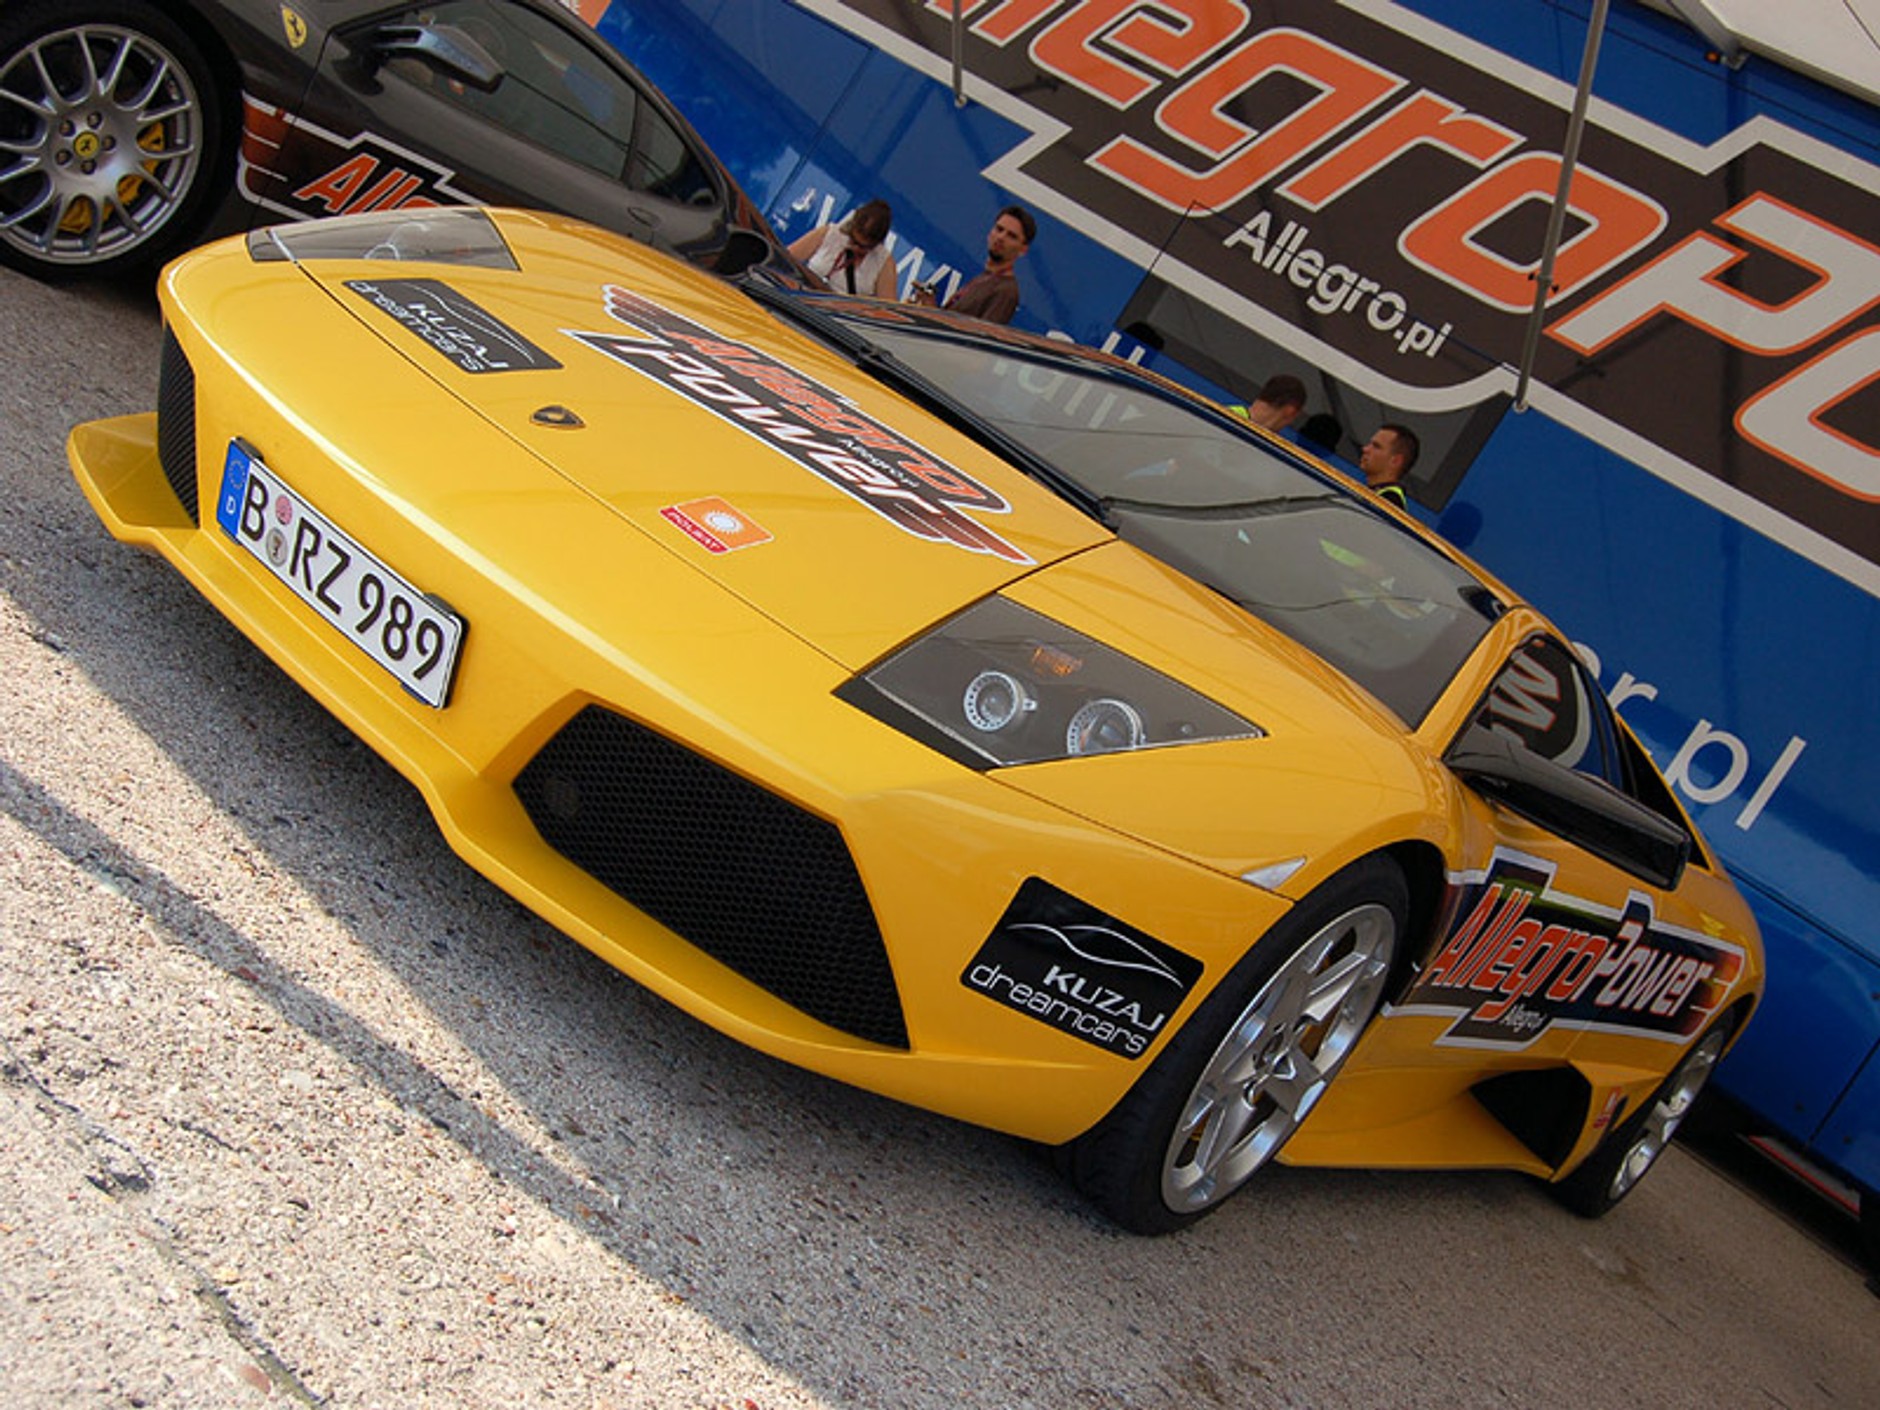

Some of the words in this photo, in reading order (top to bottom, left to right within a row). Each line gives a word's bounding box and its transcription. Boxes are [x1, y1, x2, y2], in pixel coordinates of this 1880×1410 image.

[293, 152, 440, 215] All
[408, 303, 509, 368] KUZAJ
[240, 475, 269, 543] B
[289, 516, 352, 616] RZ
[355, 572, 444, 681] 989
[969, 963, 1148, 1055] dreamcars
[1042, 964, 1165, 1032] KUZAJ
